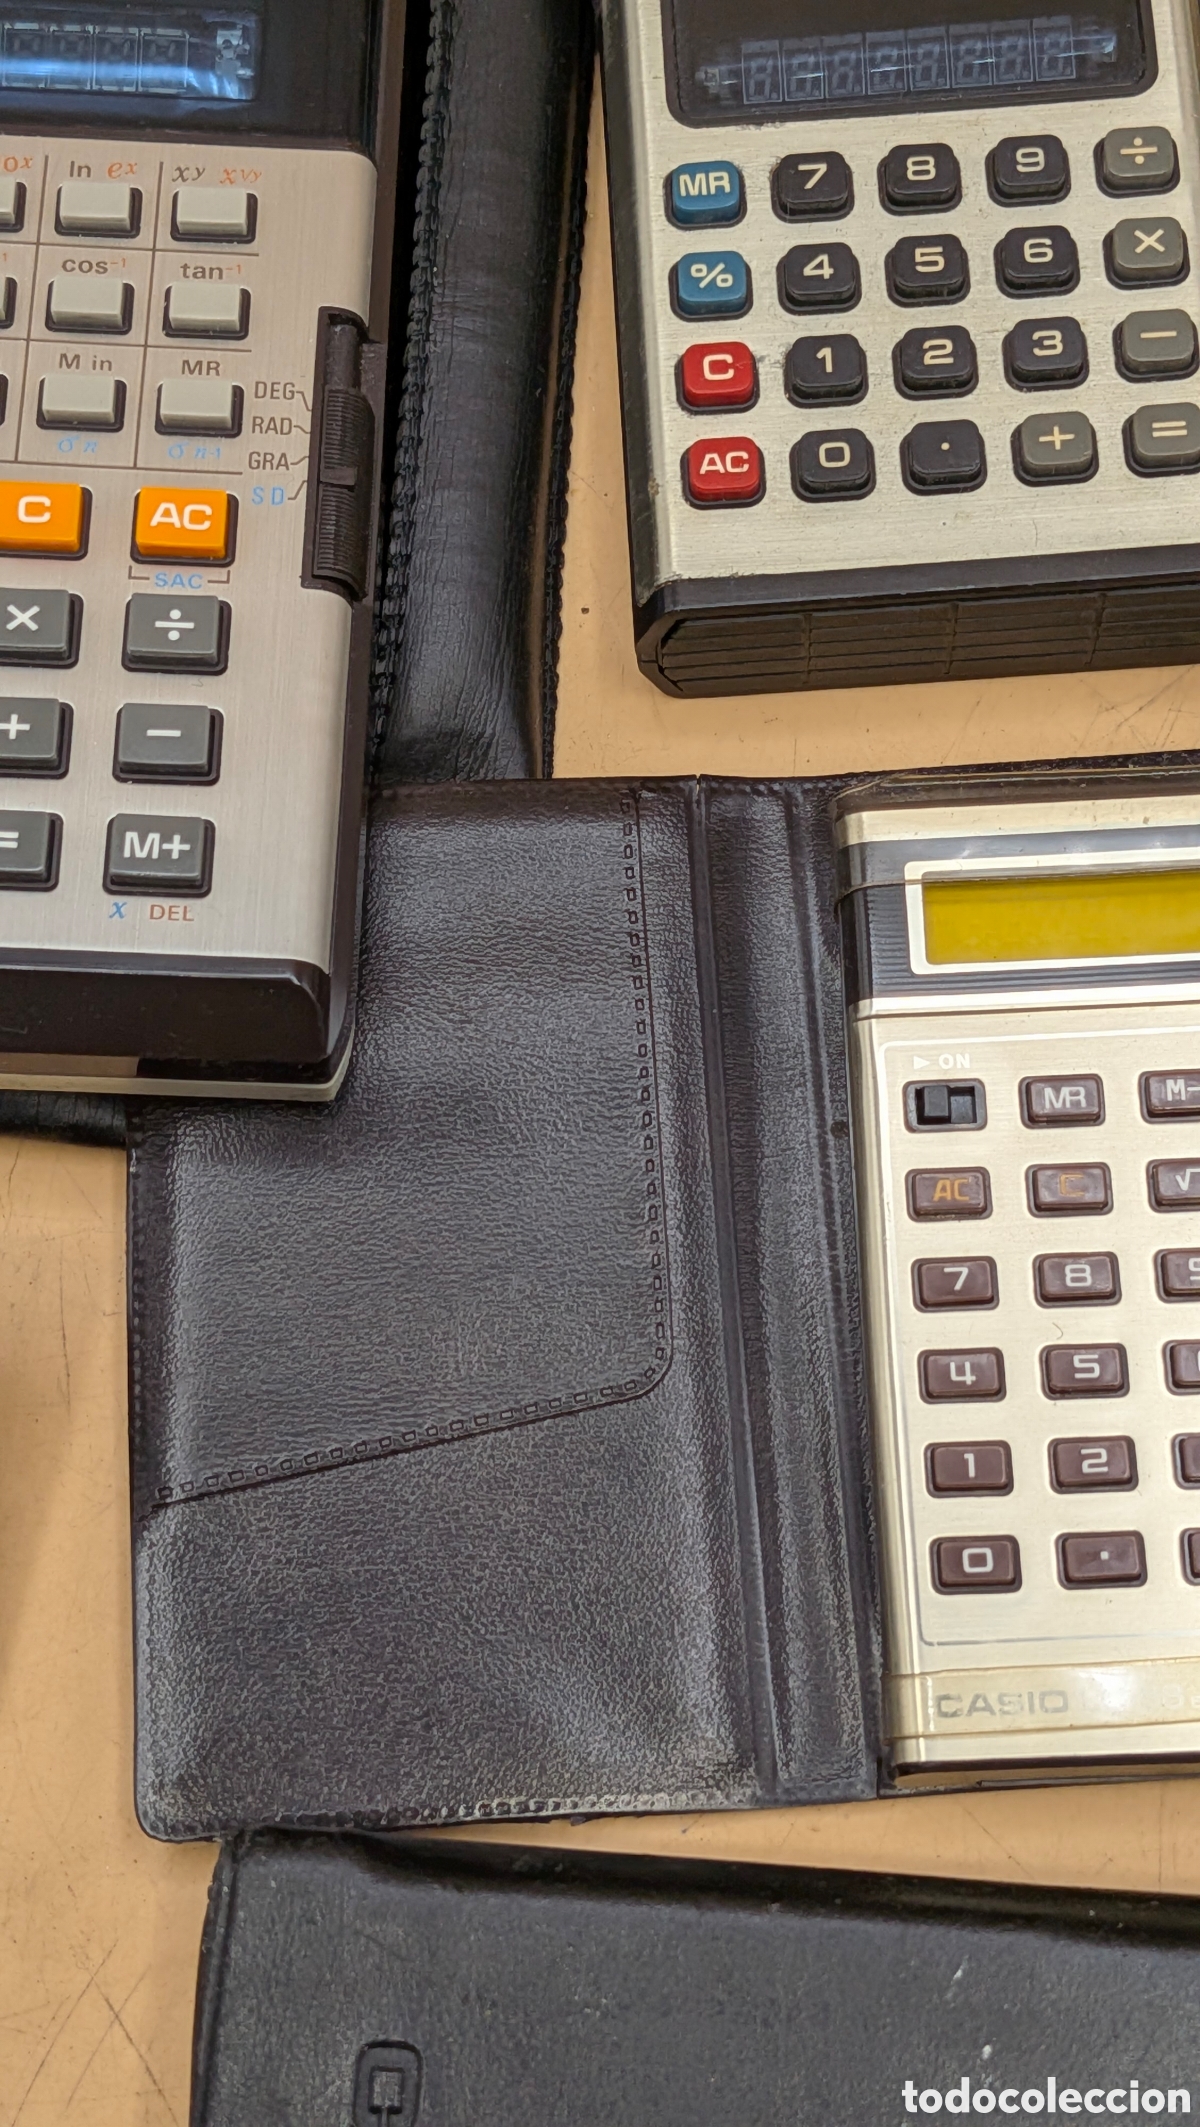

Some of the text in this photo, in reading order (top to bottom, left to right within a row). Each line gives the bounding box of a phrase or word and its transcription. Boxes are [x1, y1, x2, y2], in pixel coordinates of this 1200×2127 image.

[906, 156, 936, 181] 8
[1015, 147, 1045, 173] 9
[679, 171, 731, 196] MR
[798, 163, 828, 190] 7
[915, 248, 945, 273] 5
[1023, 238, 1054, 263] 6
[690, 263, 733, 289] %
[803, 254, 834, 280] 4
[923, 339, 954, 365] 2
[1032, 330, 1064, 356] 3
[182, 359, 221, 376] MR
[703, 354, 734, 381] C
[815, 347, 833, 374] 1
[254, 381, 295, 400] DEG
[252, 416, 293, 435] RAD
[248, 451, 290, 471] GRA
[699, 451, 750, 475] AC
[18, 496, 51, 523] C
[150, 502, 213, 531] AC
[155, 572, 202, 589] SAC
[124, 831, 191, 860] M+
[150, 904, 194, 921] DEL
[938, 1053, 970, 1069] ON
[1044, 1086, 1086, 1109] MR
[932, 1178, 970, 1201] AC
[1058, 1174, 1084, 1197] C
[943, 1267, 970, 1290] 7
[1064, 1264, 1092, 1287] 8
[949, 1361, 976, 1385] 4
[1073, 1355, 1100, 1379] 5
[963, 1452, 975, 1479] 1
[1080, 1448, 1109, 1474] 2
[934, 1689, 1069, 1719] CASIO
